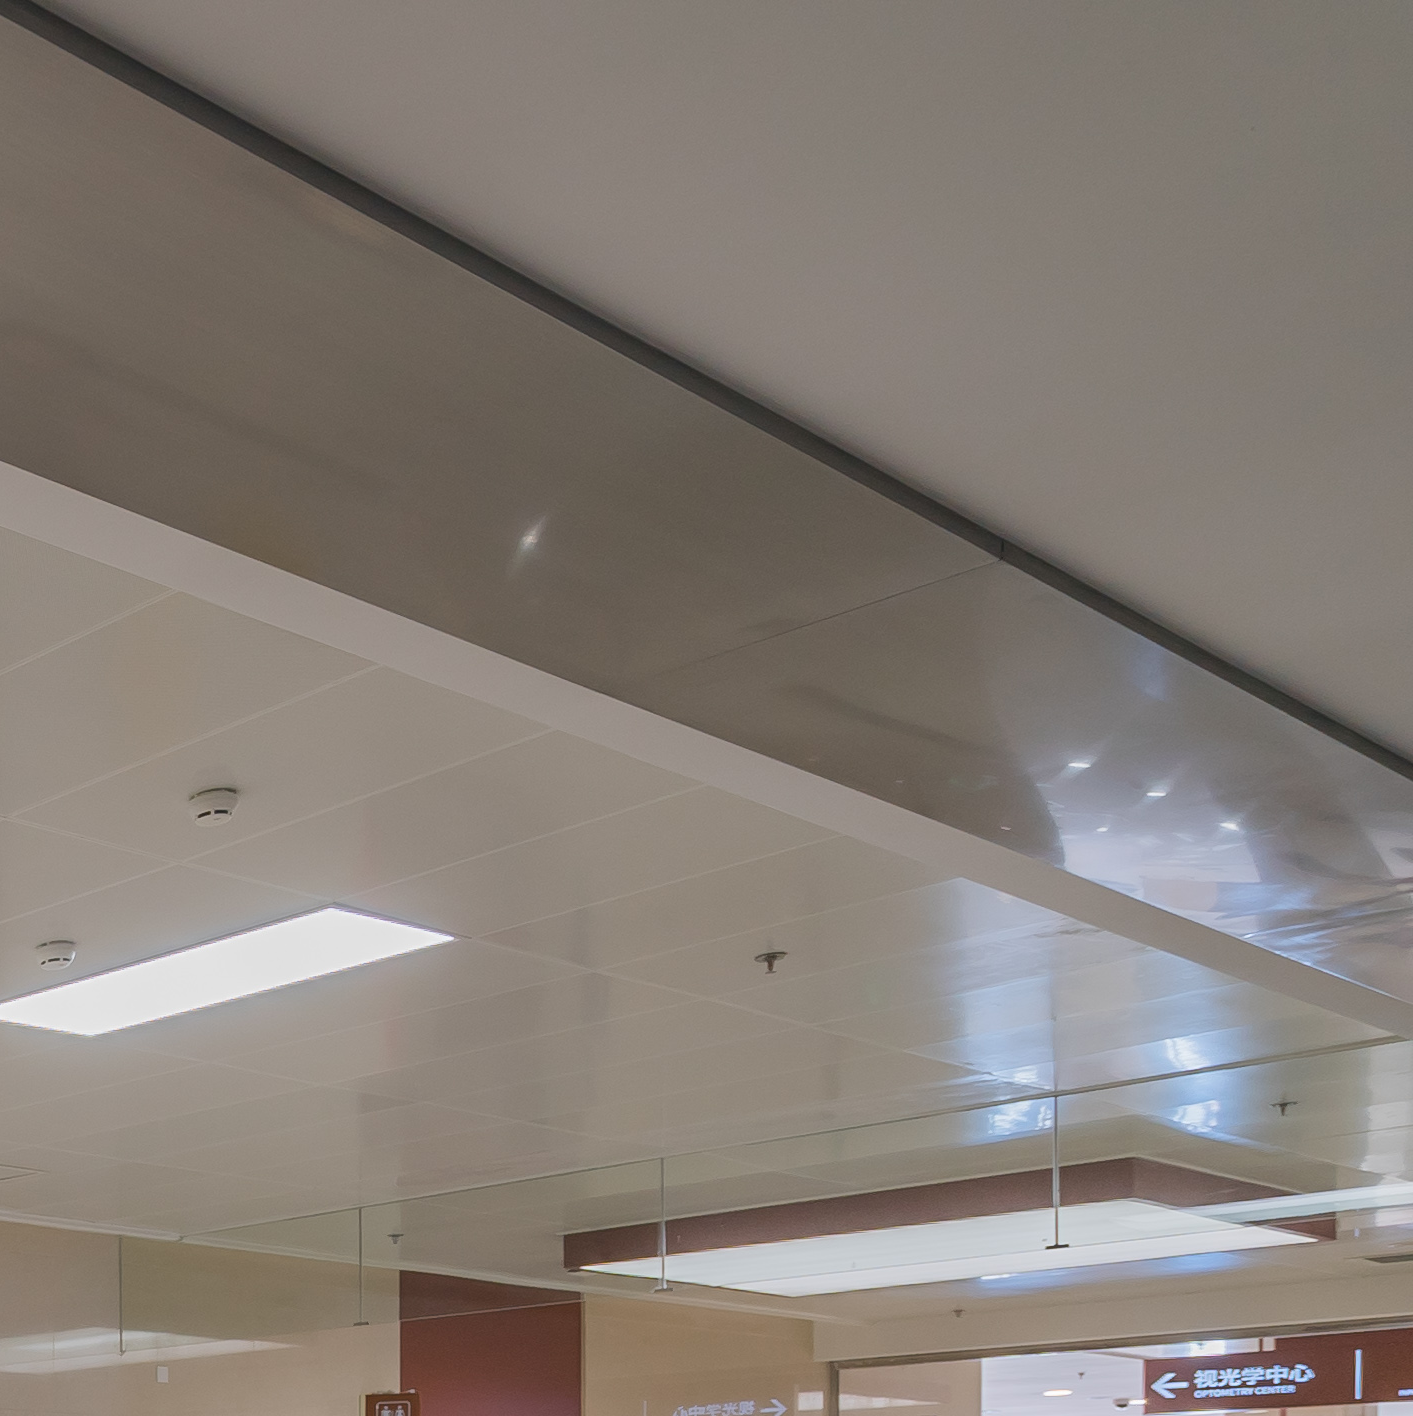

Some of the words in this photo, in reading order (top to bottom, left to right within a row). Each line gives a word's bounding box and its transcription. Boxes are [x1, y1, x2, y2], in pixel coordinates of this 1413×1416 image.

[1194, 1364, 1315, 1389] 视光学中心
[1194, 1387, 1254, 1399] OPTOMETRY
[1254, 1385, 1296, 1395] CENTER
